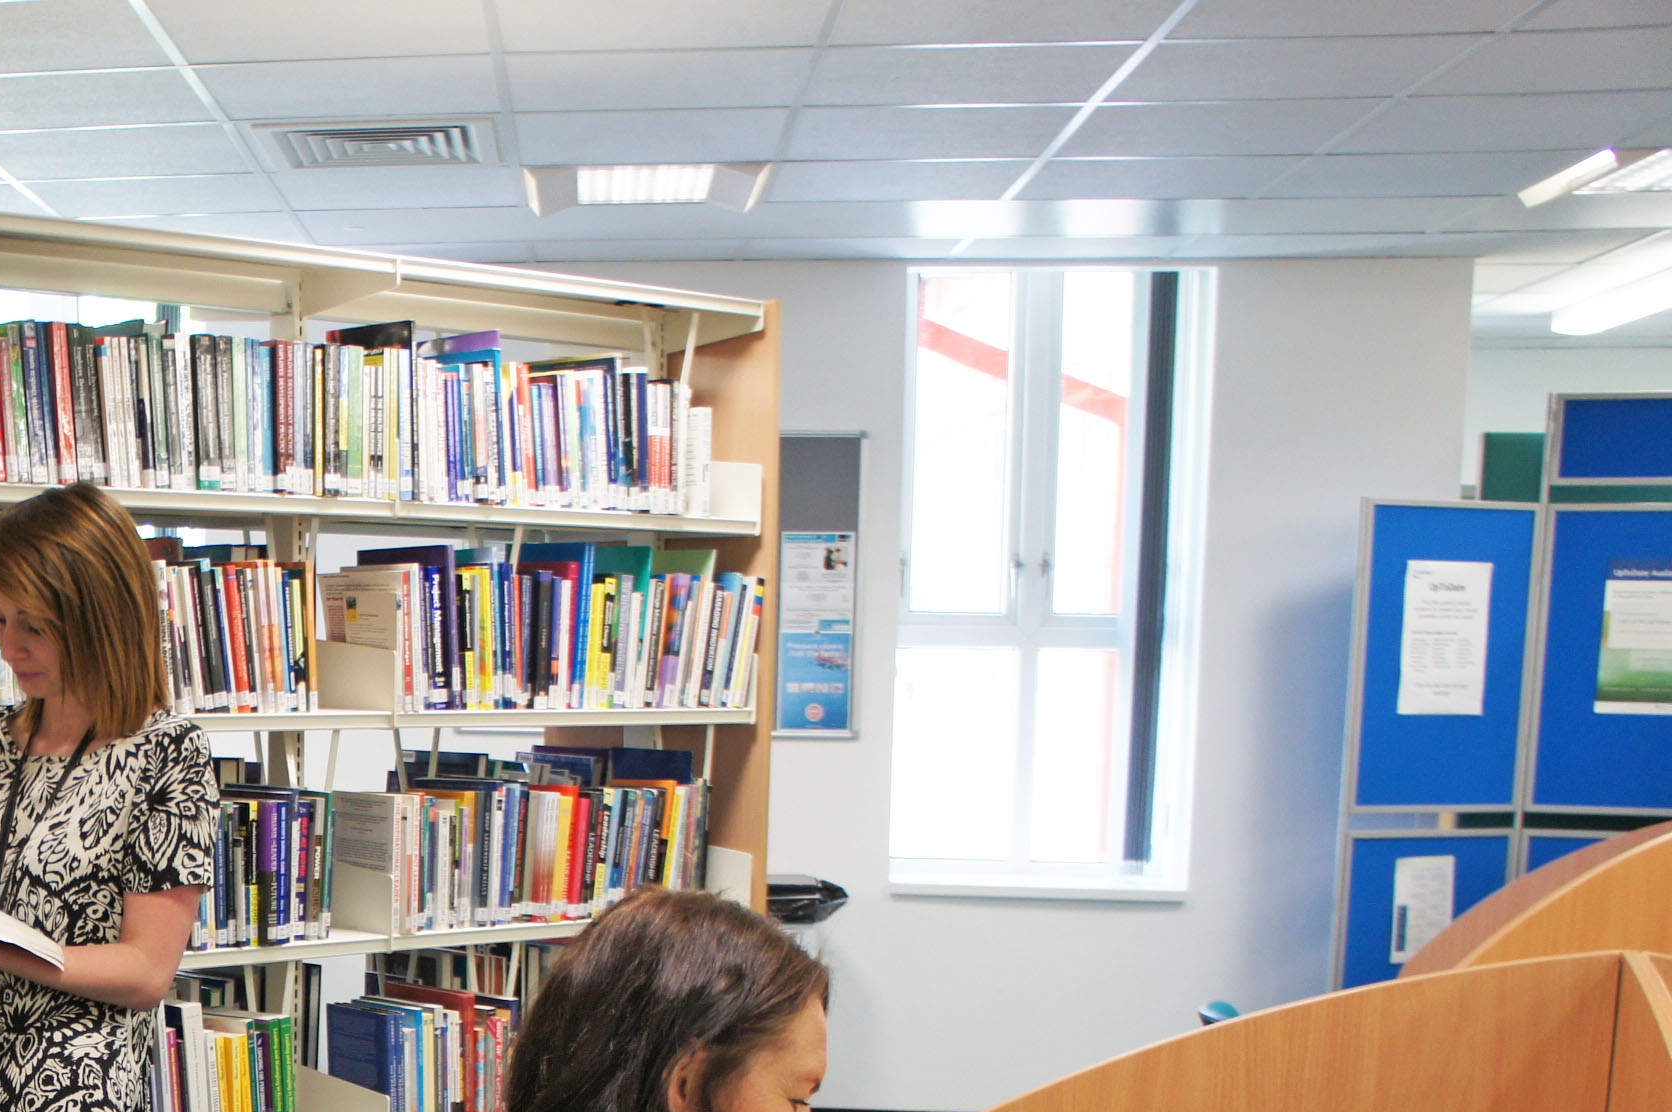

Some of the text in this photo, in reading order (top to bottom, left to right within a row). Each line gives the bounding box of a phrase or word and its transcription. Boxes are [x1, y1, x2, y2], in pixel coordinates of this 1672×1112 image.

[432, 574, 444, 674] Project Management
[705, 590, 723, 671] MANAGING INNOVATION
[482, 833, 490, 871] LEADERSHIP
[584, 832, 596, 885] LEADERSHIP
[599, 810, 610, 858] Leadership
[647, 828, 660, 880] LEADERSHIP
